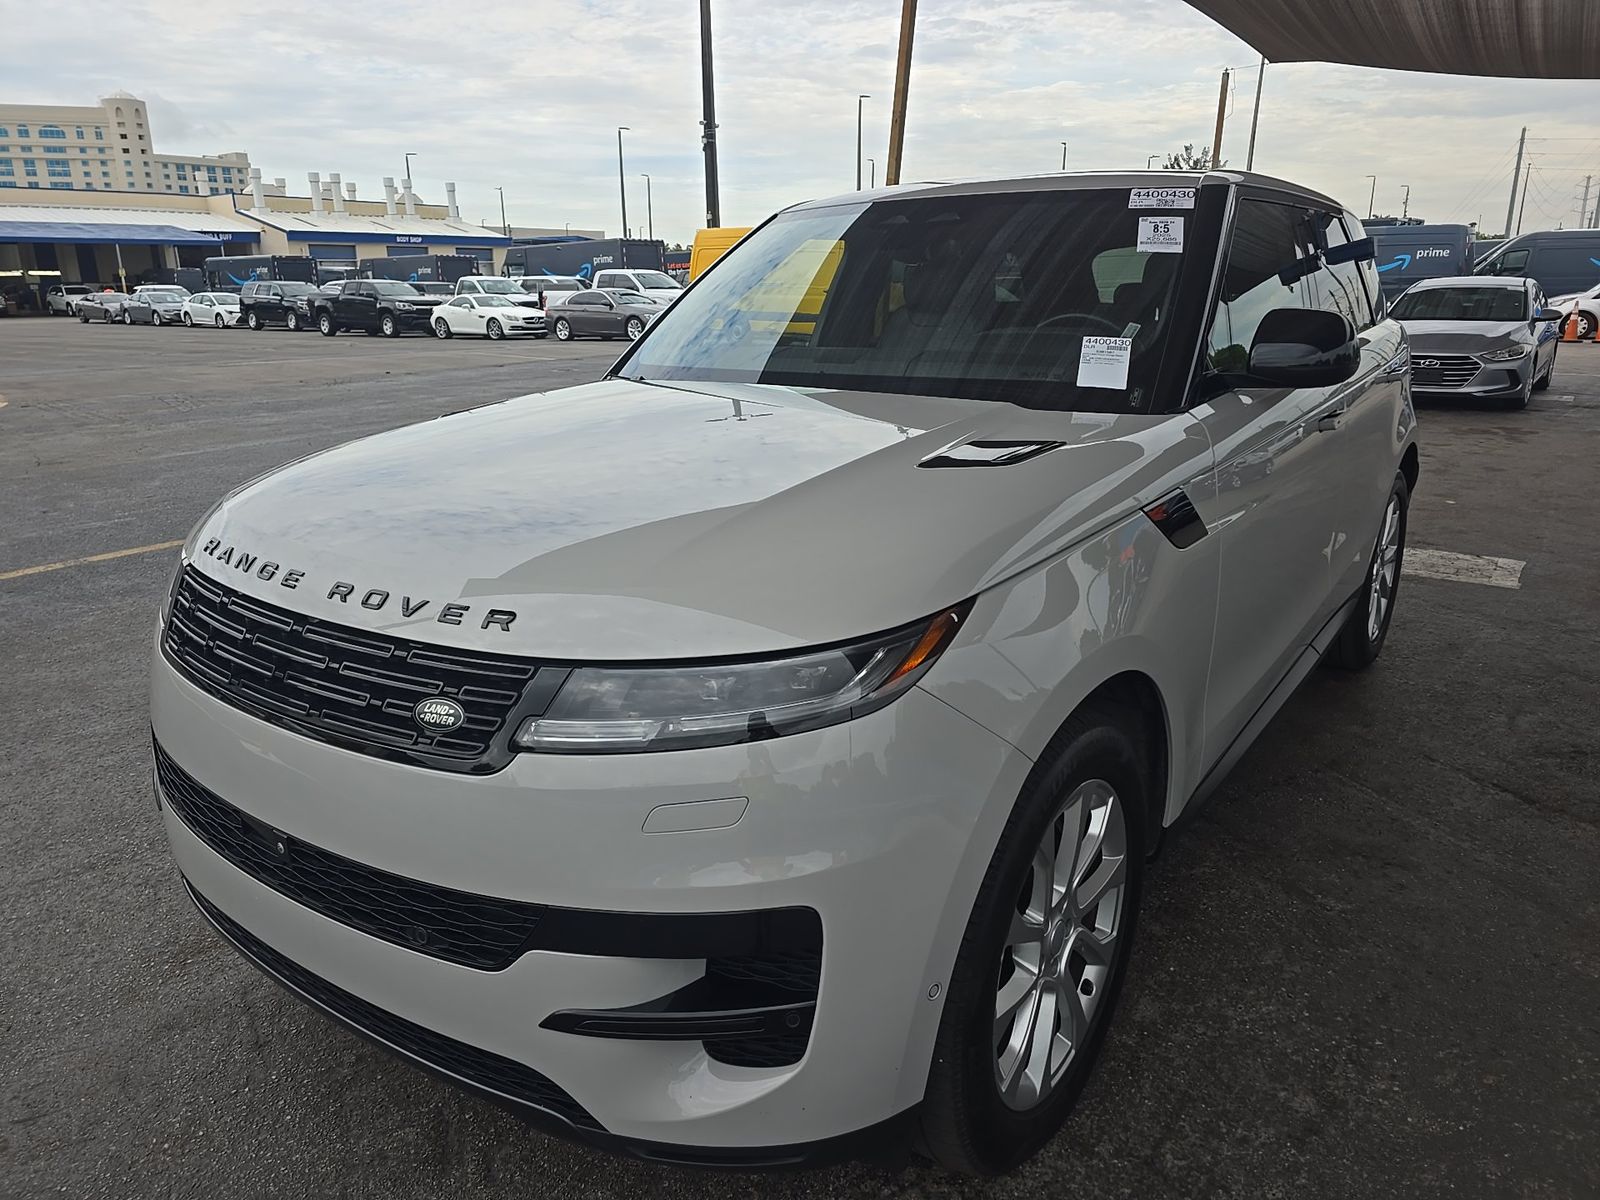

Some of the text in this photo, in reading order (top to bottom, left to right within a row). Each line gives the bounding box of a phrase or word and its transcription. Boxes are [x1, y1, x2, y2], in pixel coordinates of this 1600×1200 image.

[1133, 190, 1196, 199] 4400430
[1152, 223, 1170, 234] 8:5
[396, 235, 423, 243] BODY SHOP
[1416, 247, 1450, 260] prime
[593, 254, 614, 266] prime
[417, 263, 432, 276] prime
[1085, 337, 1131, 347] 4400430
[202, 536, 518, 632] RANGE ROVER
[423, 703, 451, 715] LAND
[422, 712, 455, 727] ROVER
